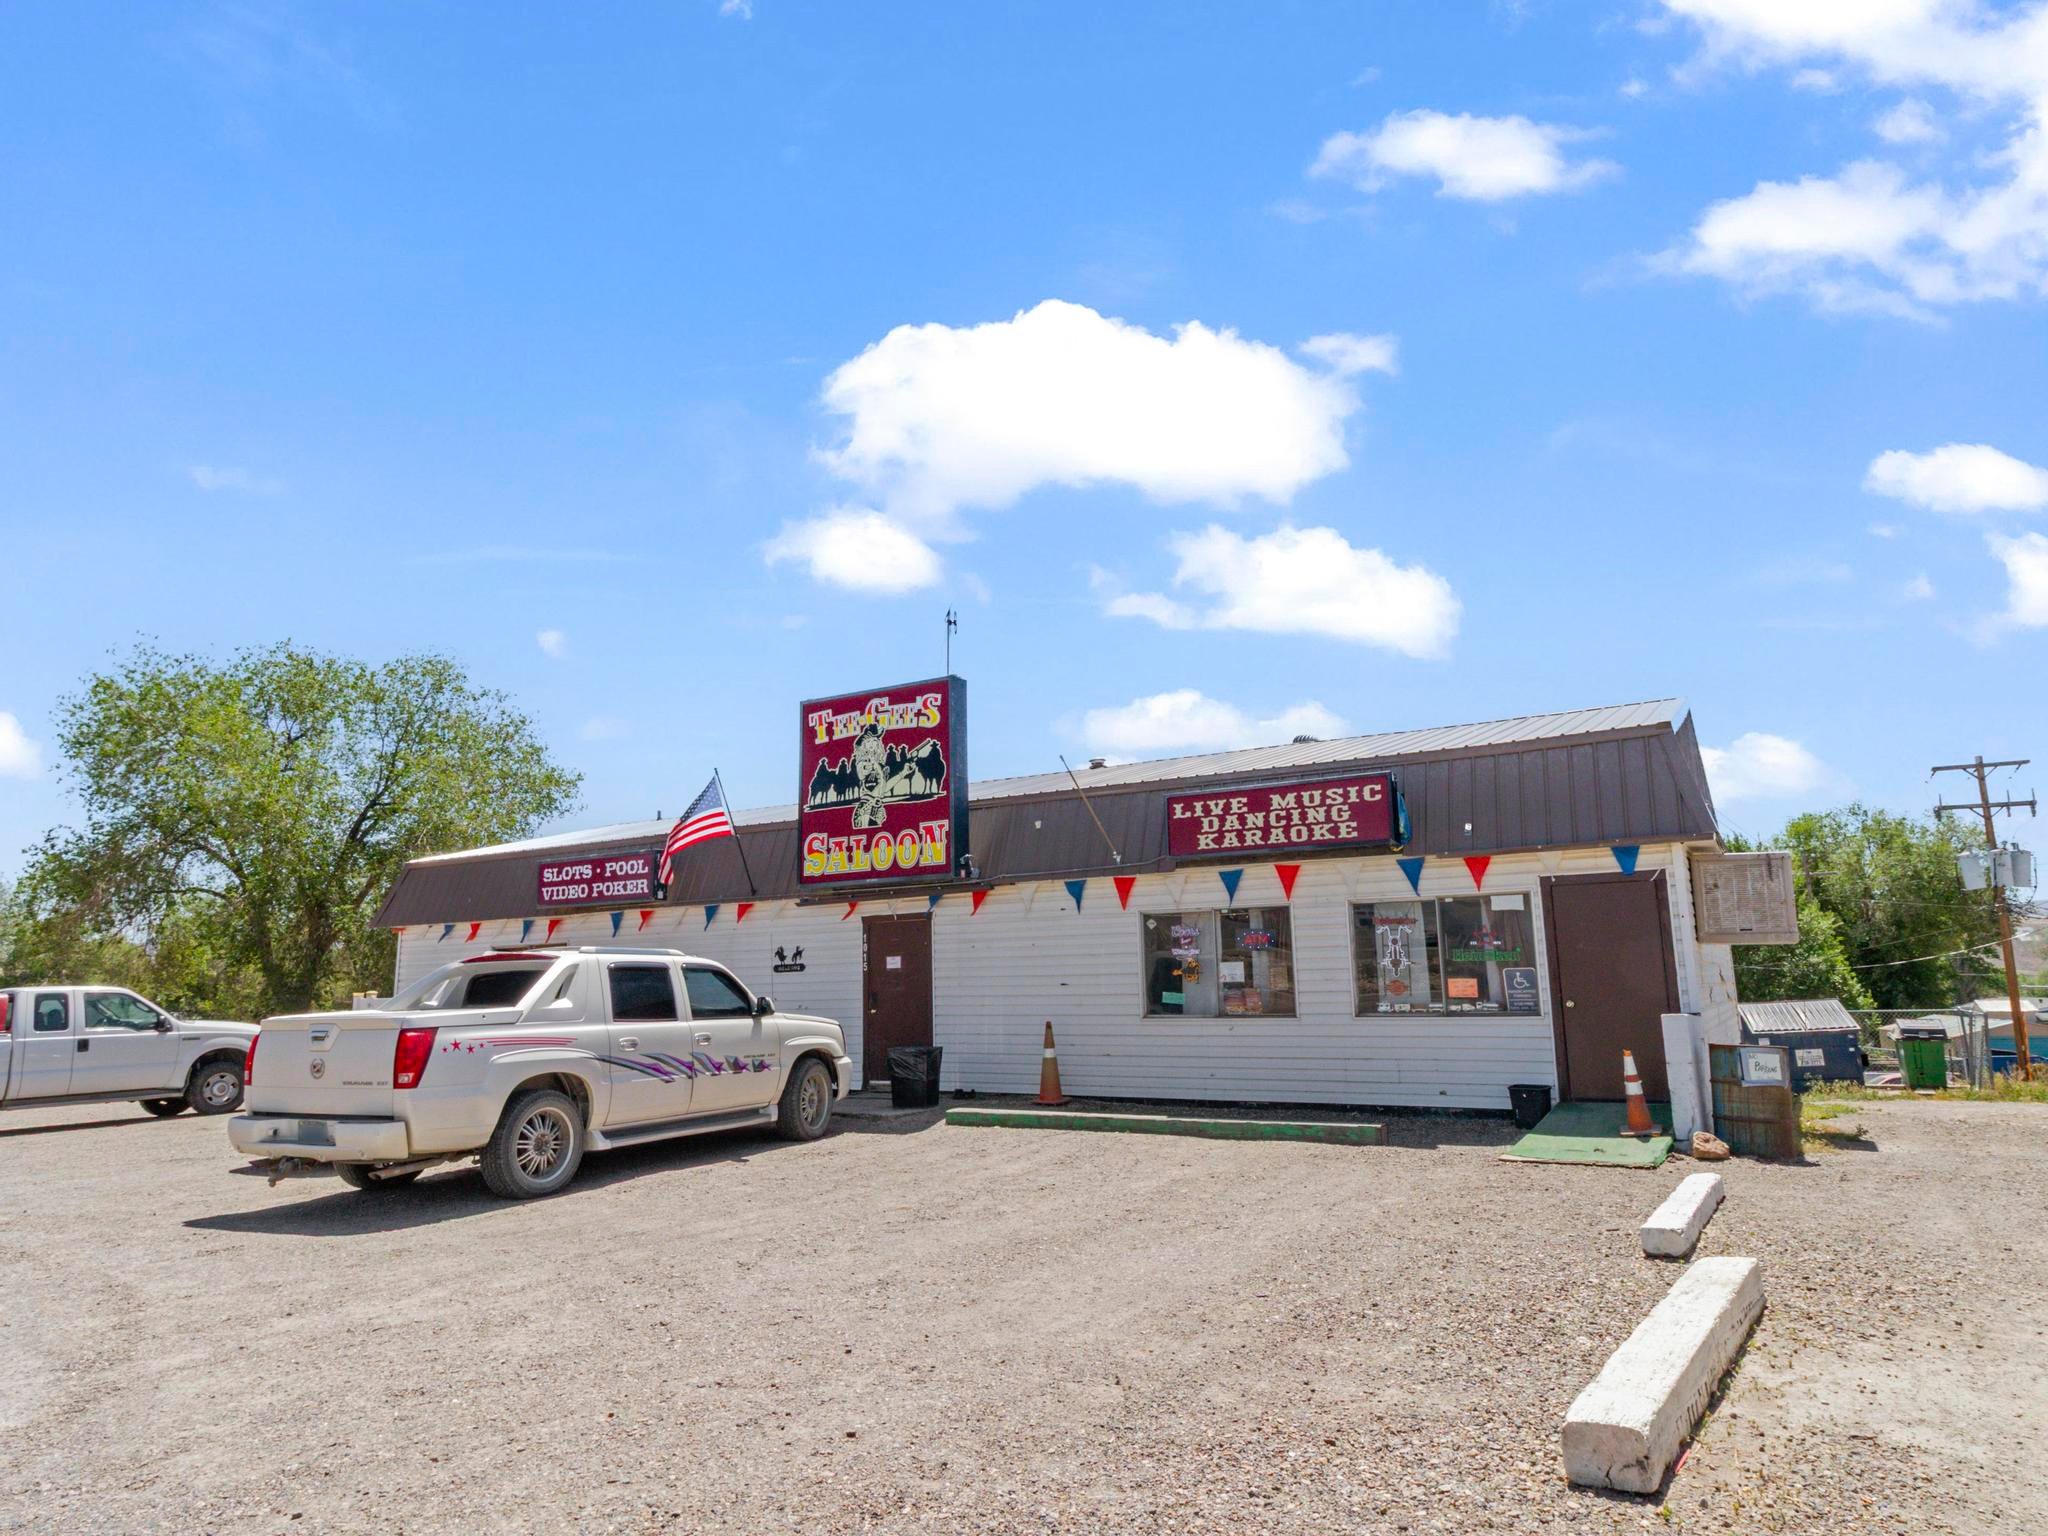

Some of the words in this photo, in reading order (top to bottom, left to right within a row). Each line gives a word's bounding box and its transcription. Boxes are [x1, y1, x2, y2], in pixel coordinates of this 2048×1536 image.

[1172, 797, 1248, 819] LIVE
[1269, 784, 1383, 810] MUSIC
[1200, 804, 1351, 833] DANCING
[804, 819, 949, 876] SALOON
[1197, 821, 1358, 850] KARAOKE
[543, 864, 593, 882] SLOTS
[604, 859, 649, 877] POOL
[541, 884, 588, 900] VIDEO
[592, 879, 649, 897] POKER
[1244, 934, 1271, 945] ATM
